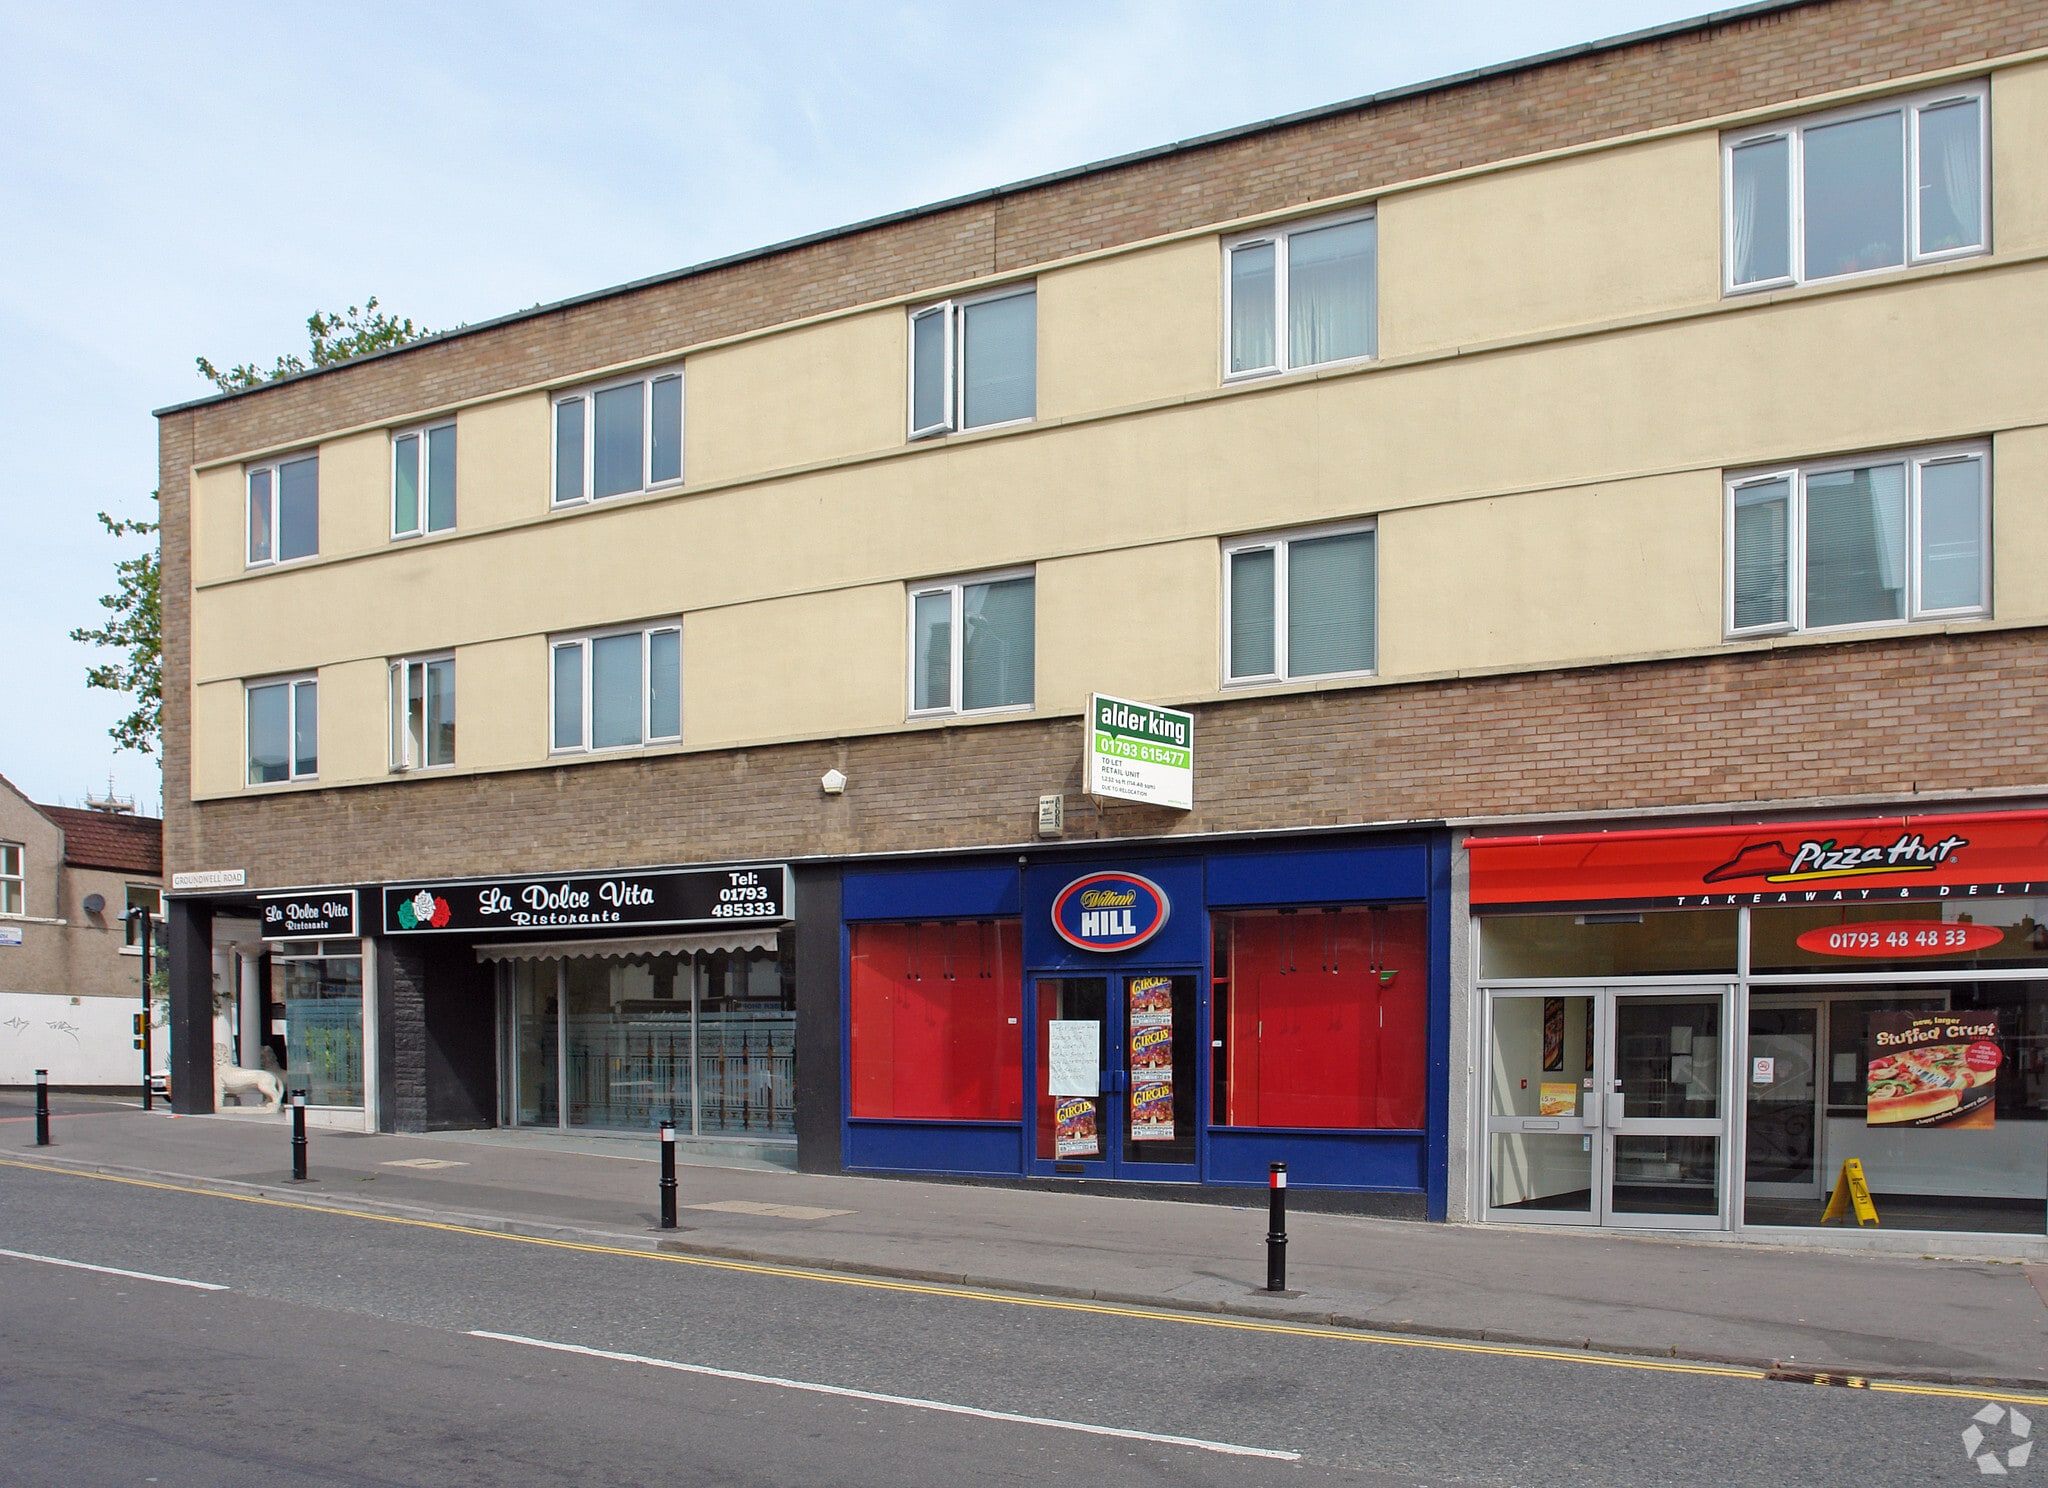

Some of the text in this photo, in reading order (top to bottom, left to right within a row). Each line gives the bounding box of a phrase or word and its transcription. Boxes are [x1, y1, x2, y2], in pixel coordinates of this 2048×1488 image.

[1101, 703, 1185, 745] alder king
[1101, 738, 1185, 766] 01793 615477
[1101, 757, 1122, 767] TO LET
[1101, 766, 1140, 779] RETAIL UNIT
[1790, 835, 1966, 874] Pizza Hut
[174, 873, 242, 885] GROUNDWELL ROAD
[728, 871, 758, 886] Tel:
[478, 880, 655, 915] La Dolce Vita
[719, 886, 768, 902] 01793
[1080, 889, 1137, 909] William
[1677, 889, 1870, 906] TAKEAWAY
[1900, 888, 1910, 898] &
[265, 901, 349, 923] La Dolce Vita
[510, 909, 621, 926] Ristorante
[711, 901, 776, 917] 485333
[1081, 909, 1137, 937] HILL
[1829, 929, 1966, 948] 01793 48 48 33
[1912, 1017, 1960, 1027] new, larger
[1132, 1029, 1169, 1051] CIRCUS
[1876, 1022, 1996, 1046] Stuffed Crust
[1133, 1085, 1170, 1107] CIRCUS
[1057, 1101, 1092, 1123] CIRCUS
